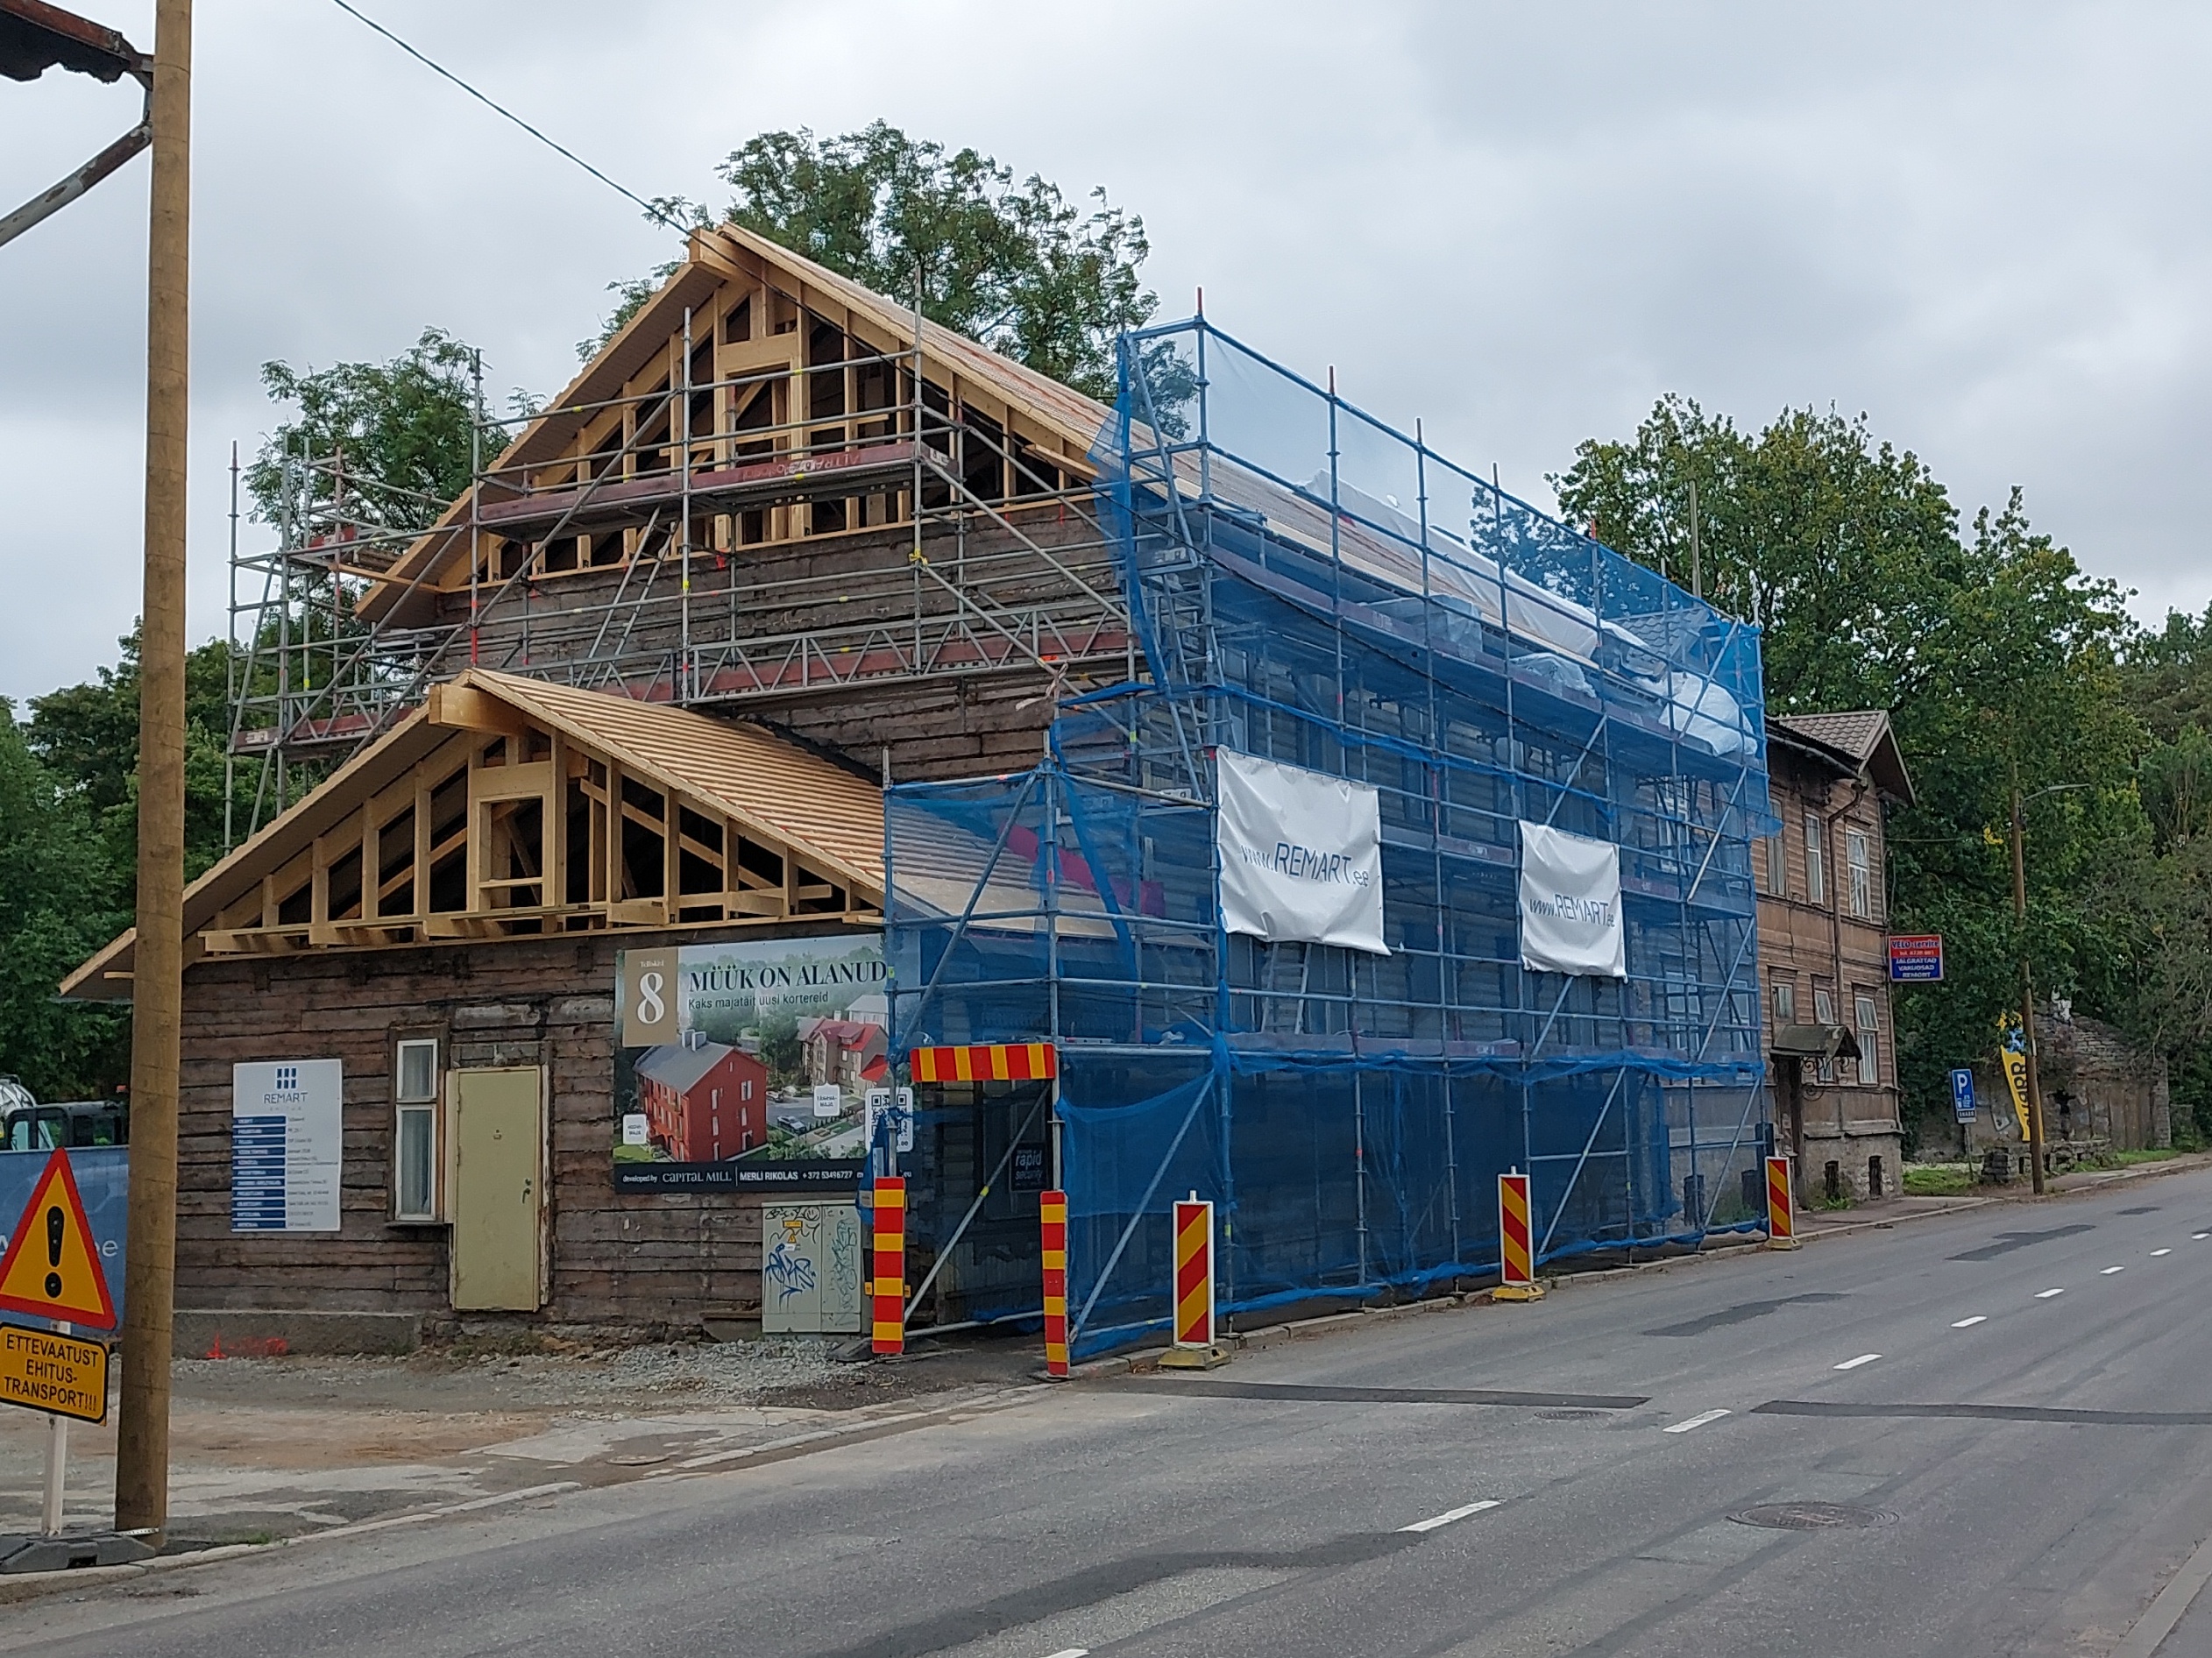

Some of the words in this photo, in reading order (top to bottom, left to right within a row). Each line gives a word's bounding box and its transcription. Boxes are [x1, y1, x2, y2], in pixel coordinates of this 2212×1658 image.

[1241, 842, 1369, 888] www.REMART.ee
[1529, 893, 1615, 928] www.REMART.ee
[689, 965, 755, 992] MÜÜK
[759, 966, 791, 989] ON
[795, 960, 887, 987] ALANUD
[636, 971, 665, 1024] 8
[689, 997, 713, 1010] Kaks
[783, 991, 828, 1006] kortereid
[264, 1092, 308, 1104] REMART
[1956, 1073, 1968, 1095] P
[1015, 1149, 1042, 1170] rapid
[705, 1171, 732, 1182] MILL
[740, 1171, 763, 1181] MERLI
[765, 1171, 798, 1180] RIKOLAS
[803, 1171, 820, 1180] +372
[6, 1333, 99, 1367] ETTEVAATUST
[26, 1358, 77, 1384] EHITUS-
[4, 1376, 96, 1412] TRANSPORT!!!
